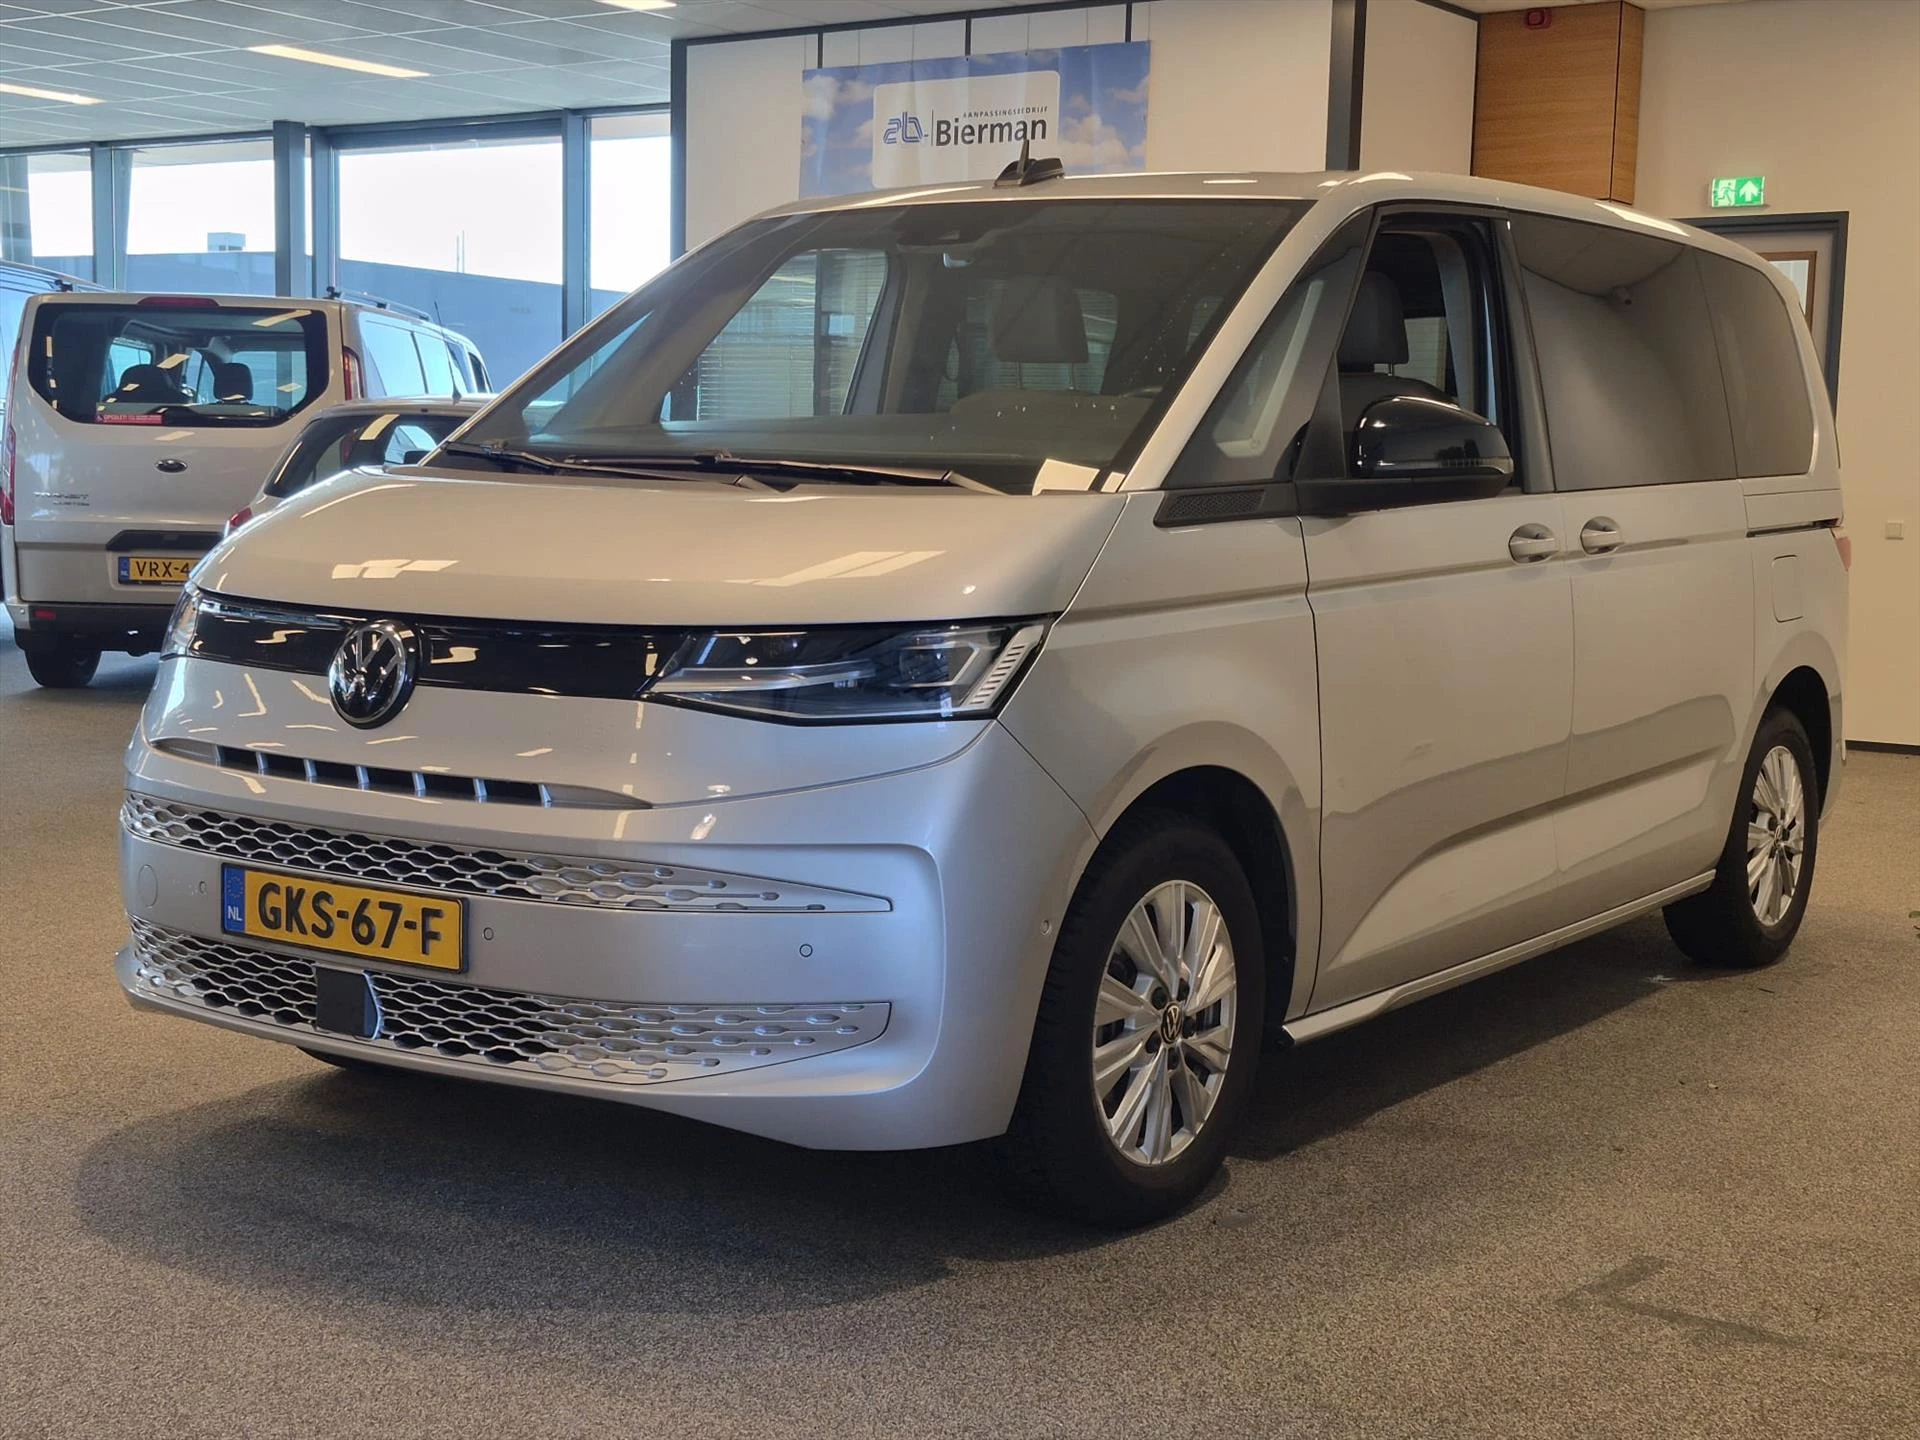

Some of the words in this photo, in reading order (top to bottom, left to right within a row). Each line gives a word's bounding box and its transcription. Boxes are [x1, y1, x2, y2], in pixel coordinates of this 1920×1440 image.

[935, 118, 1047, 147] Bierman
[227, 905, 243, 922] NL
[258, 882, 444, 955] GKS-67-F
